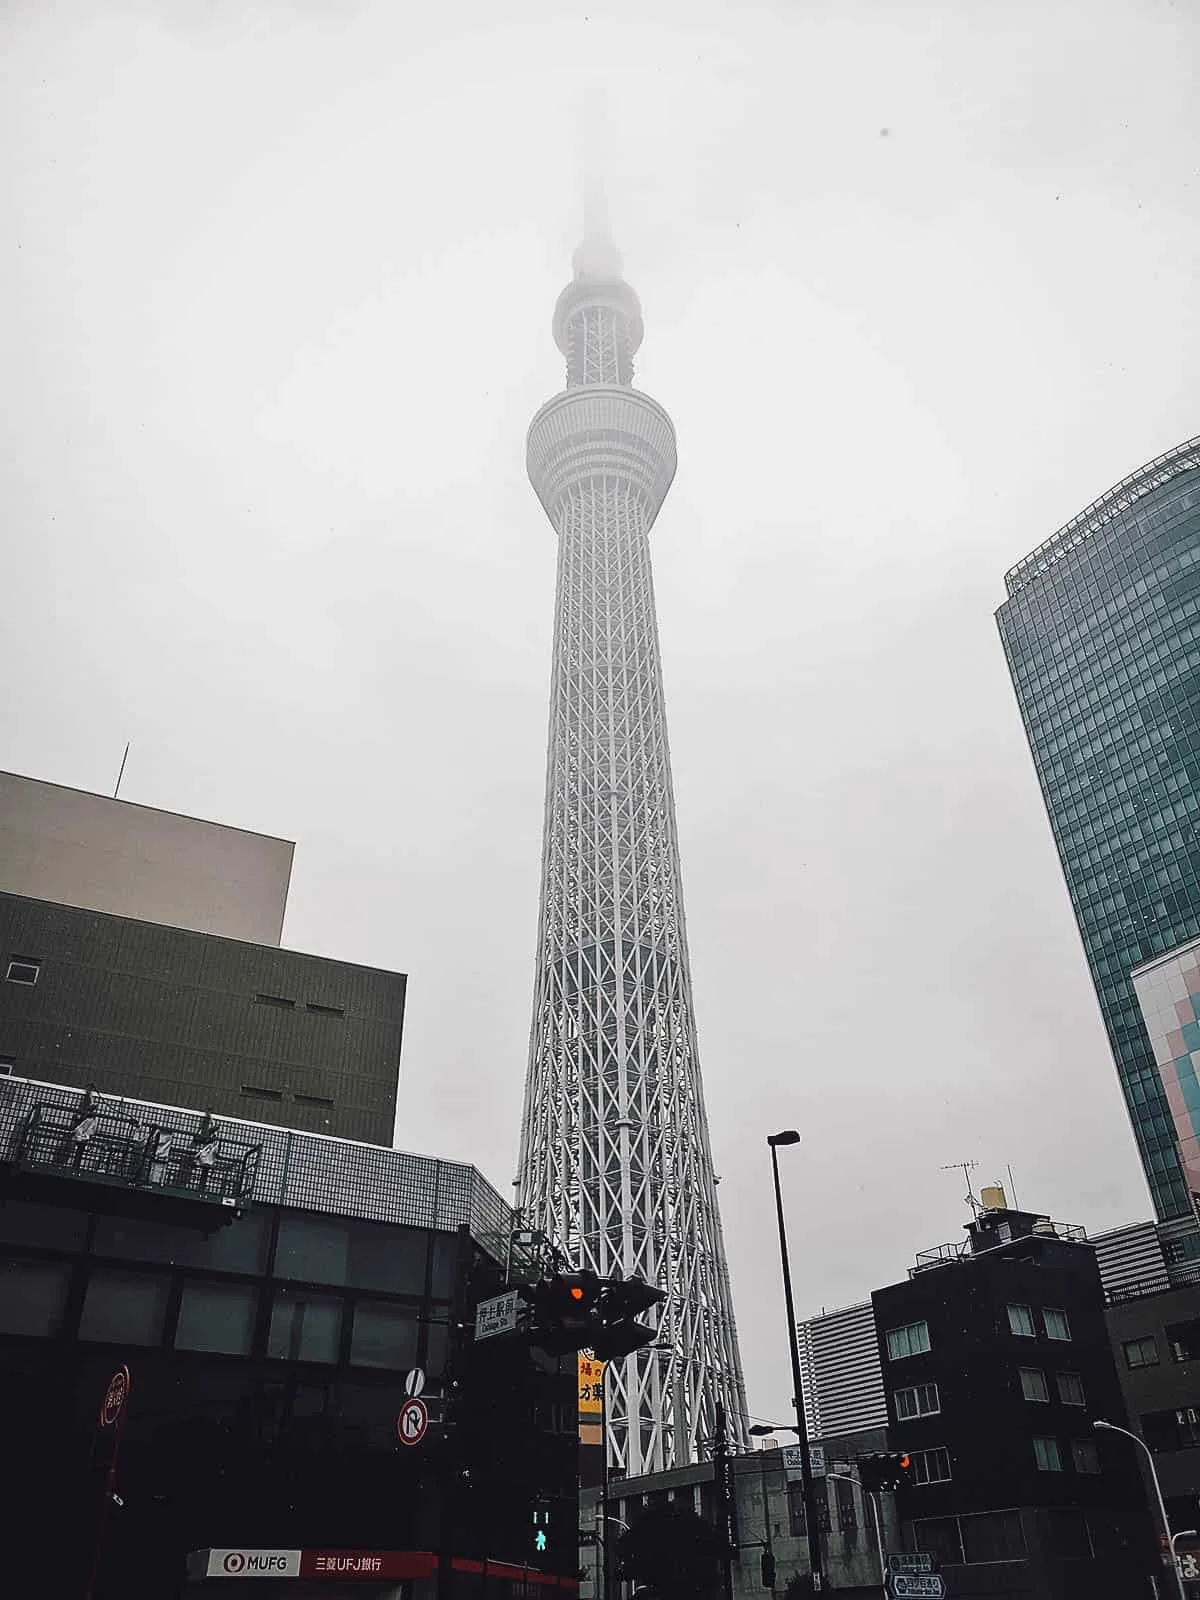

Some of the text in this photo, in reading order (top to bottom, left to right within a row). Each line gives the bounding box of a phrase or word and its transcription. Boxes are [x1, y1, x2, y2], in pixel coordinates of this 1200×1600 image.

[480, 1298, 514, 1322] 押上駅前
[247, 1556, 287, 1570] MUFG
[315, 1557, 382, 1572] 三菱UFJ銀行
